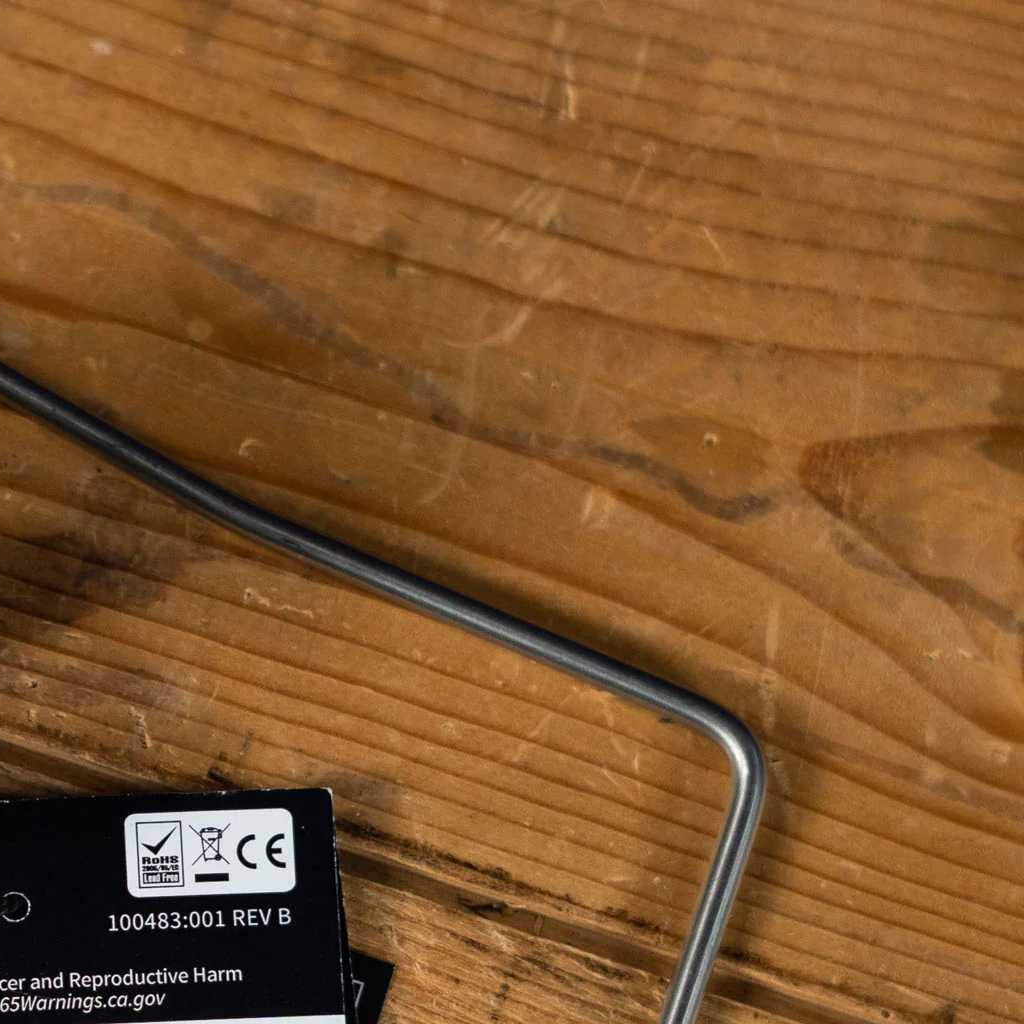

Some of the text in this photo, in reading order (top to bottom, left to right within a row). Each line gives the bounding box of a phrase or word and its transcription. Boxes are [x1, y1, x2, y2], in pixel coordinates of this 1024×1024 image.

[142, 855, 179, 865] RoHS
[236, 833, 286, 870] CE
[108, 908, 292, 932] 100483:001 REV B
[30, 972, 64, 990] and
[69, 968, 189, 990] Reproductive
[193, 967, 243, 983] Harm
